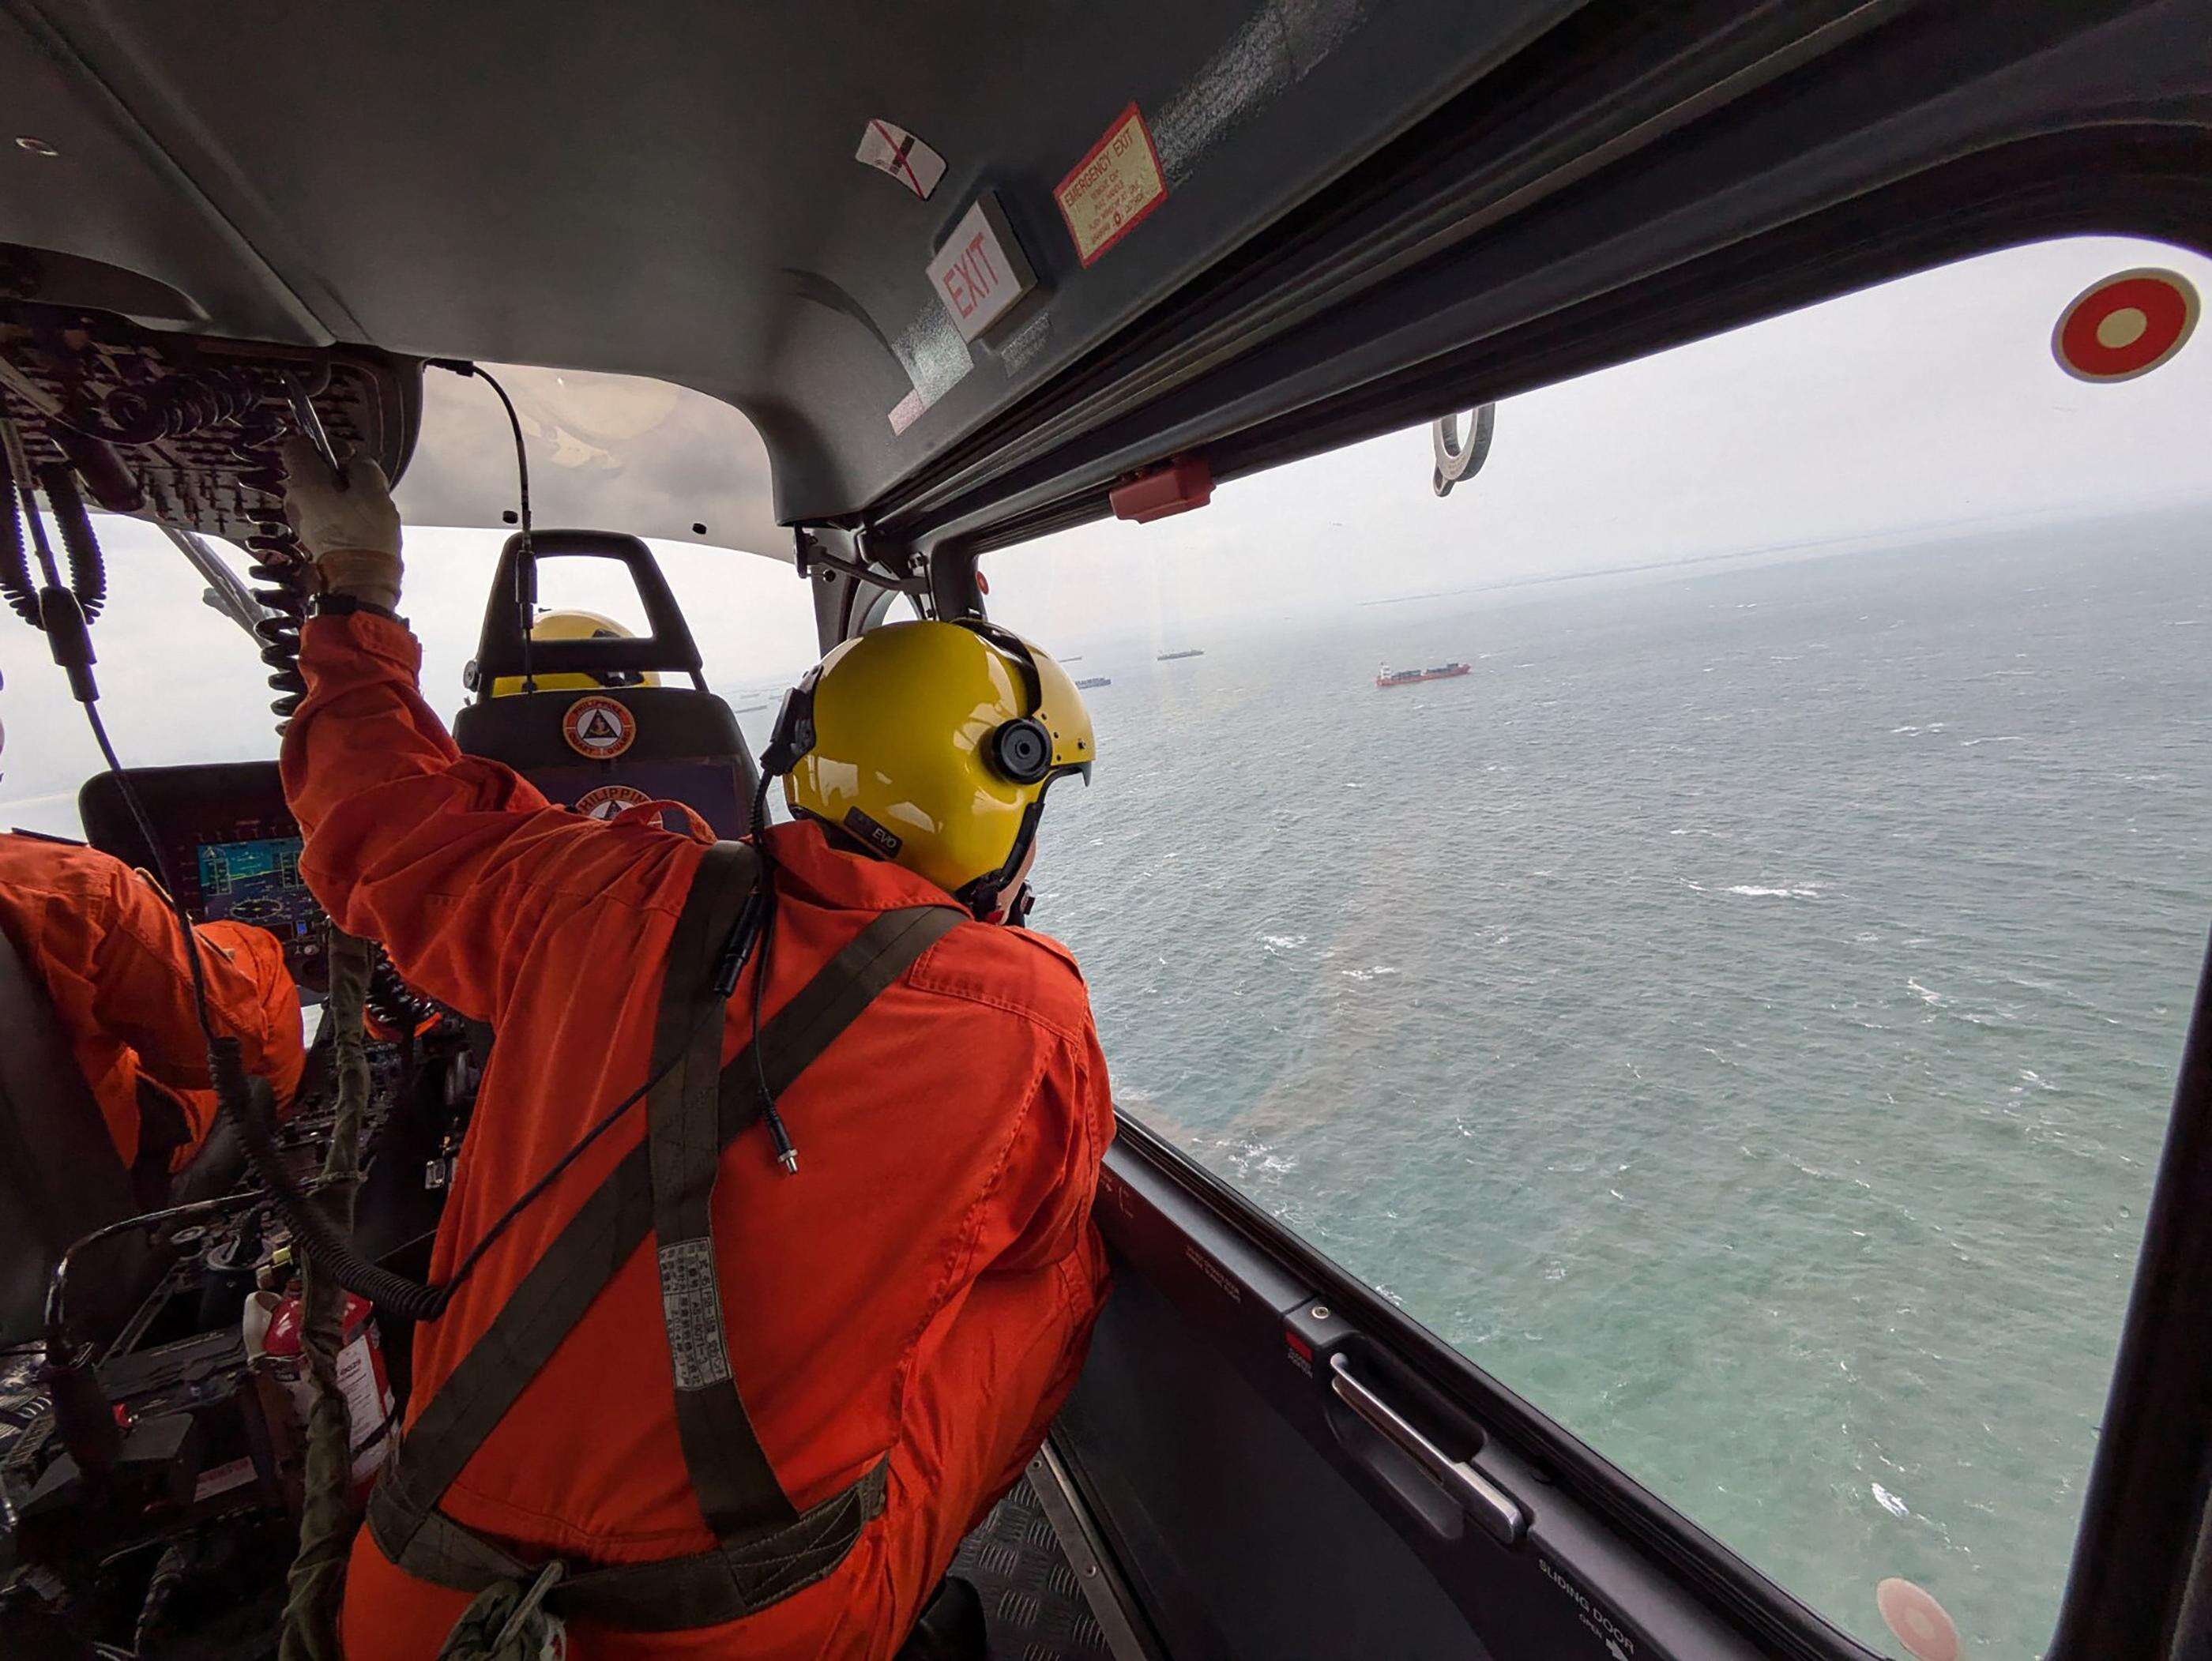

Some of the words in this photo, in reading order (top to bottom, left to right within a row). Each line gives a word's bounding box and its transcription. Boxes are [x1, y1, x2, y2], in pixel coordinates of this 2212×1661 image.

[1064, 152, 1112, 207] EMERGENCY
[1112, 128, 1133, 157] EXIT
[943, 231, 999, 319] EXIT
[572, 700, 622, 716] PHILIPPINE
[569, 731, 594, 754] COAST
[607, 729, 631, 754] GUARD
[577, 787, 647, 814] HILIPPIN
[872, 828, 897, 848] EVO
[1539, 1558, 1590, 1612] SLIDING
[1593, 1607, 1635, 1655] DOOR
[1579, 1614, 1603, 1639] OPEN
